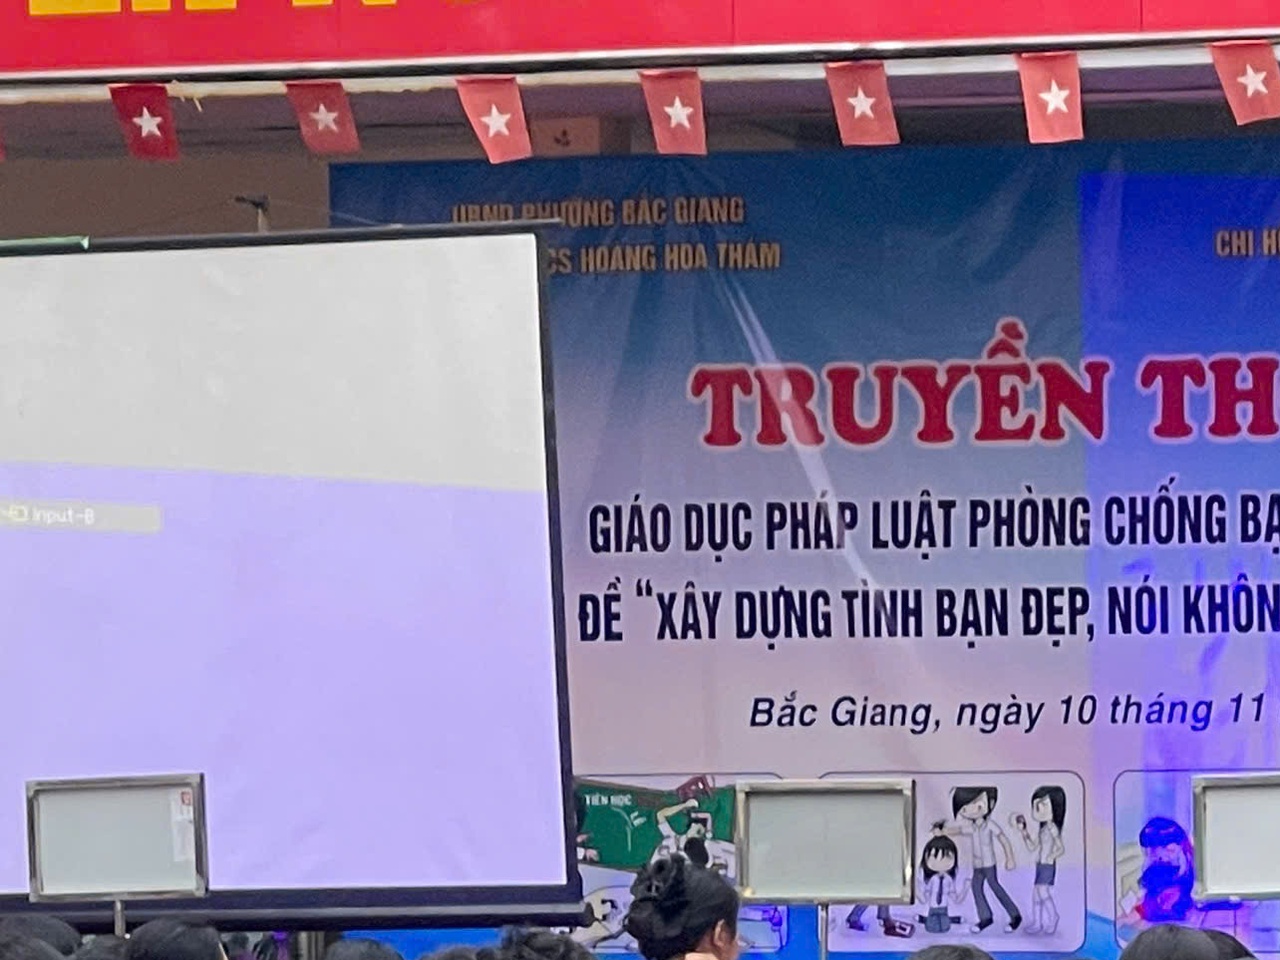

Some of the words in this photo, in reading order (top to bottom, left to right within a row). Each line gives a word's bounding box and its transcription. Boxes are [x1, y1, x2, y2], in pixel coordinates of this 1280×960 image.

[622, 189, 667, 225] BẮC
[674, 196, 744, 225] GIANG
[580, 241, 657, 273] HOÀNG
[664, 243, 709, 270] HOA
[1215, 228, 1254, 257] CHI
[690, 320, 1109, 447] TRUYỀN
[589, 494, 671, 553] GIÁO
[684, 502, 752, 562] DỤC
[766, 489, 858, 550] PHÁP
[871, 489, 956, 560] LUẬT
[968, 485, 1091, 549] PHÒNG
[1104, 477, 1227, 545] CHỐNG
[579, 576, 623, 641] ĐỀ
[636, 579, 722, 640] “XÂY
[735, 585, 832, 650] DỰNG
[841, 579, 923, 638] TÌNH
[936, 588, 1009, 648] BẠN
[1020, 587, 1094, 647] ĐẸP,
[1108, 574, 1169, 634] NÓI
[750, 691, 818, 727] Bắc
[831, 696, 941, 734] Giang,
[956, 694, 1045, 734] ngày
[1060, 694, 1098, 725] 10
[1110, 692, 1213, 731] tháng
[1229, 692, 1265, 722] 11
